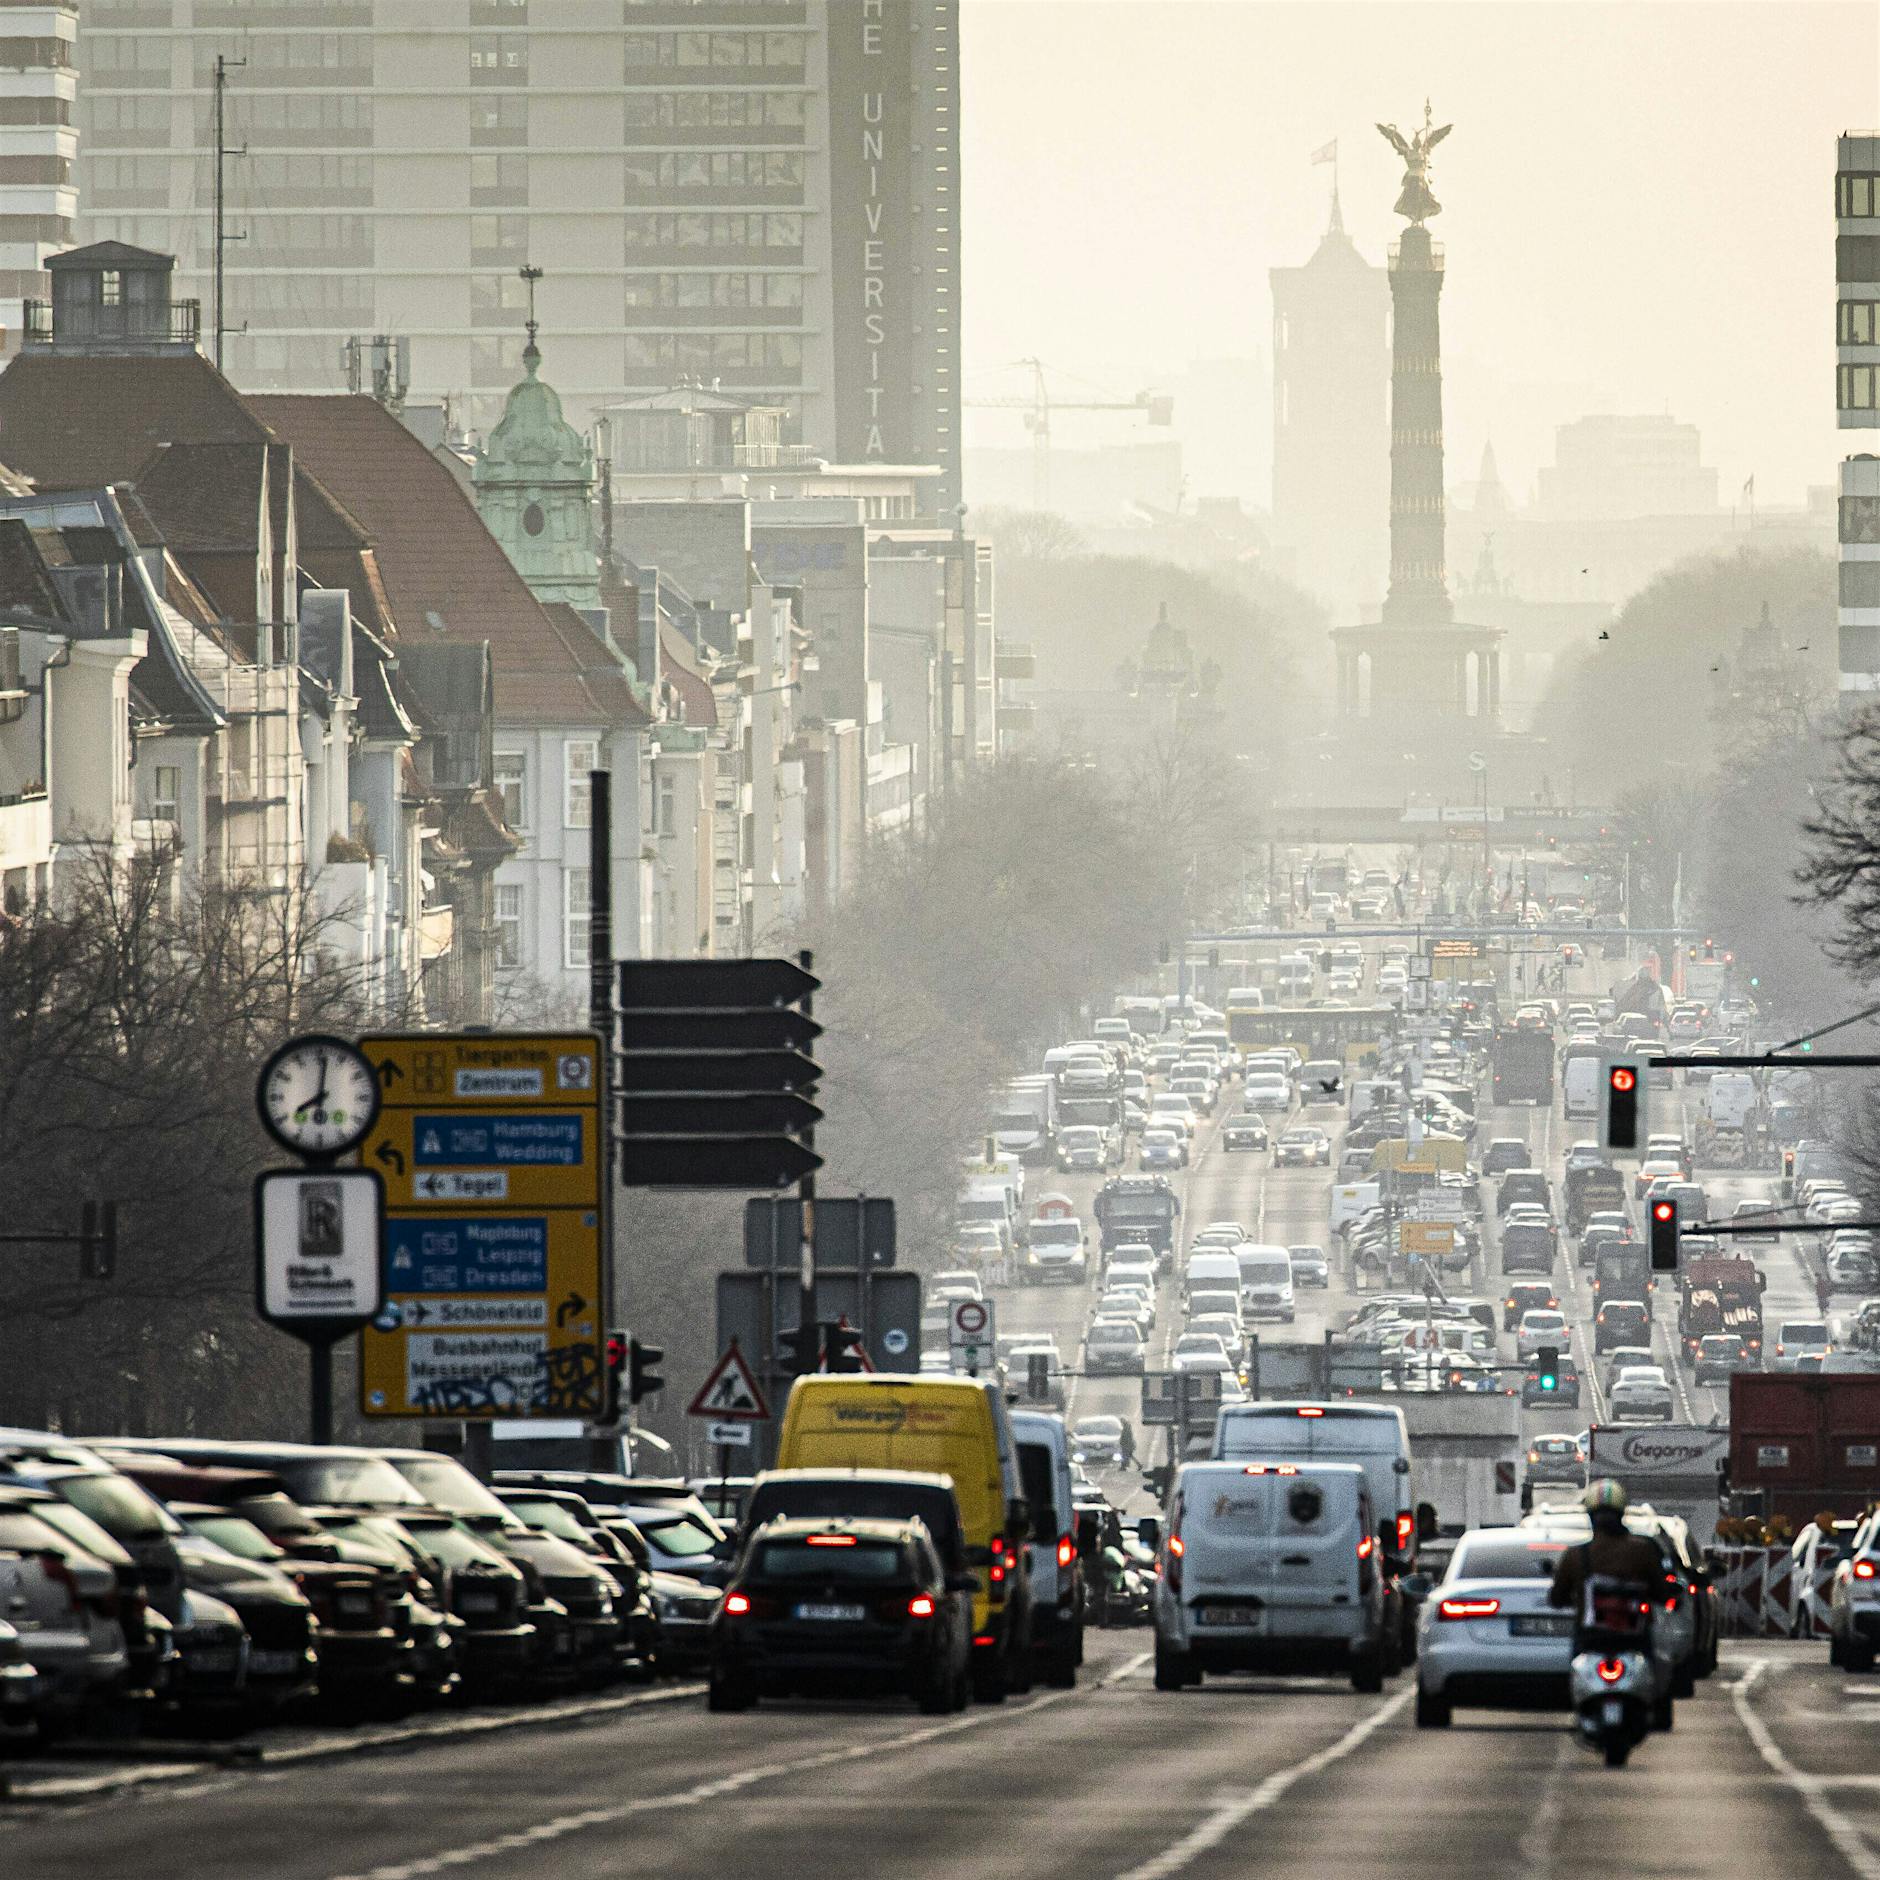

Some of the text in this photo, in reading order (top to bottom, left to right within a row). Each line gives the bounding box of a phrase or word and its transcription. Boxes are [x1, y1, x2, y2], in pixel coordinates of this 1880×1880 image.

[862, 93, 886, 465] UNIVERSITÄ
[459, 1073, 539, 1092] Zentrum
[493, 1122, 578, 1141] Hamburg
[494, 1143, 575, 1163] Wedding
[454, 1174, 502, 1197] Tegel
[466, 1225, 542, 1244] Magdeburg
[477, 1247, 542, 1266] Leipzig
[465, 1267, 542, 1285] Dresden
[440, 1302, 543, 1320] Schönefeld
